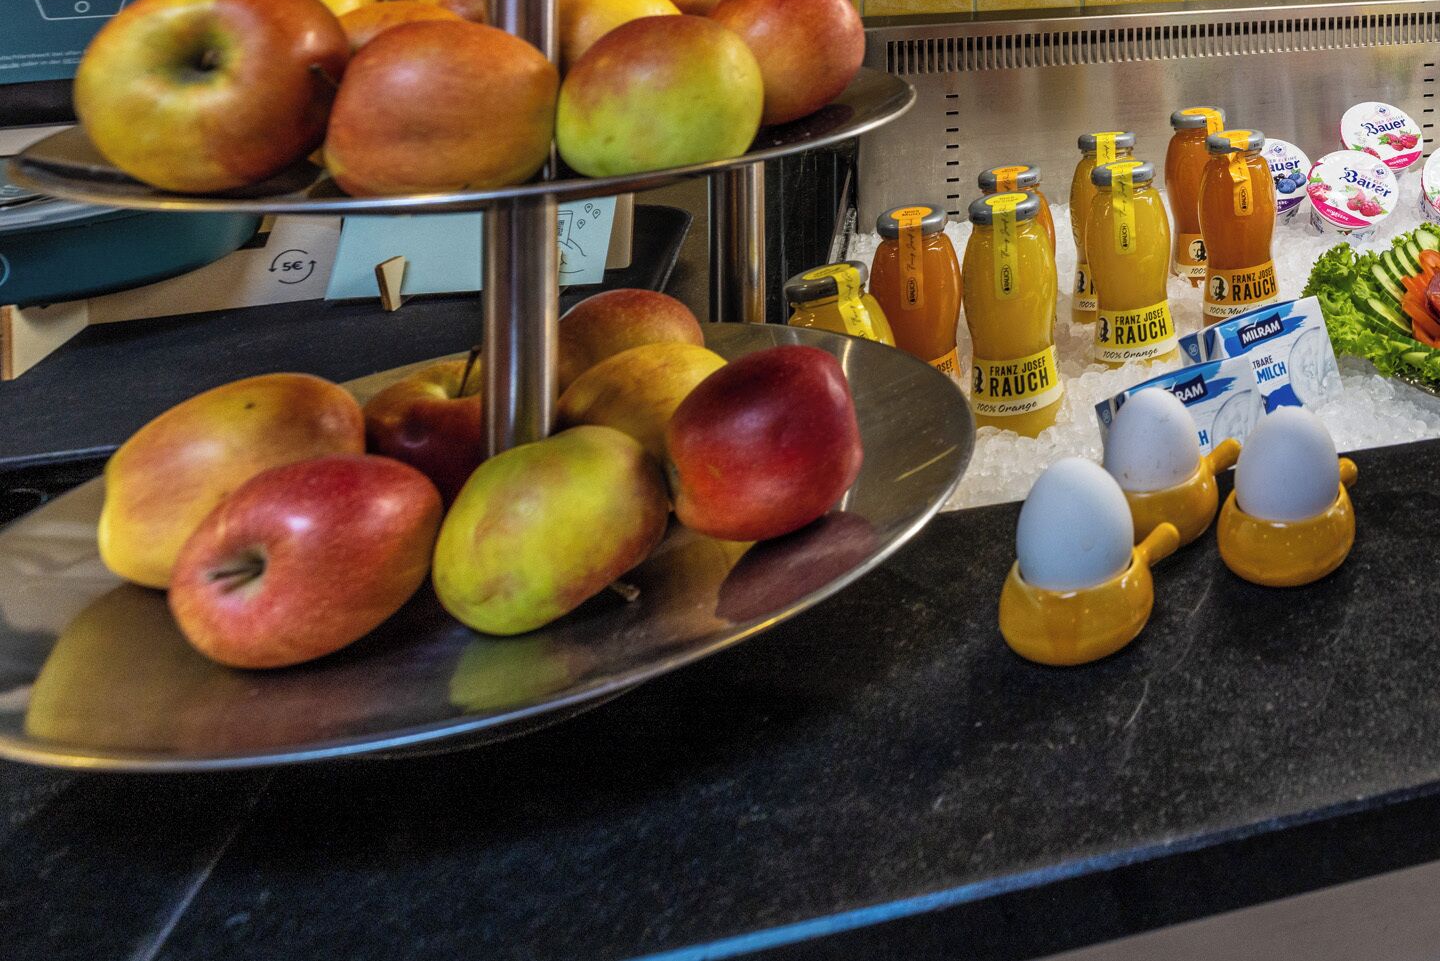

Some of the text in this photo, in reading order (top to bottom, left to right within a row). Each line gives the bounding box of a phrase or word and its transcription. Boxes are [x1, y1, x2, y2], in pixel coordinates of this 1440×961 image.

[1361, 117, 1406, 137] Bauer
[1269, 159, 1300, 172] auer
[1339, 167, 1392, 198] Bauer
[282, 260, 303, 272] 5€
[1232, 268, 1273, 283] FRANZ JOSEF
[1232, 275, 1277, 302] RAUCH
[1115, 307, 1163, 326] FRANZ JOSEF
[1209, 306, 1226, 314] 100%
[1115, 317, 1168, 345] RAUCH
[1241, 320, 1281, 344] MILRAM
[1103, 348, 1158, 359] 100% Orange
[1253, 355, 1273, 369] TBARE
[936, 358, 953, 372] OSEF
[989, 356, 1046, 377] FRANZ JOSEF
[1257, 362, 1287, 385] MILCH
[989, 367, 1050, 398] RAUCH
[1175, 383, 1204, 401] RAM
[976, 401, 1038, 413] 100% Orange
